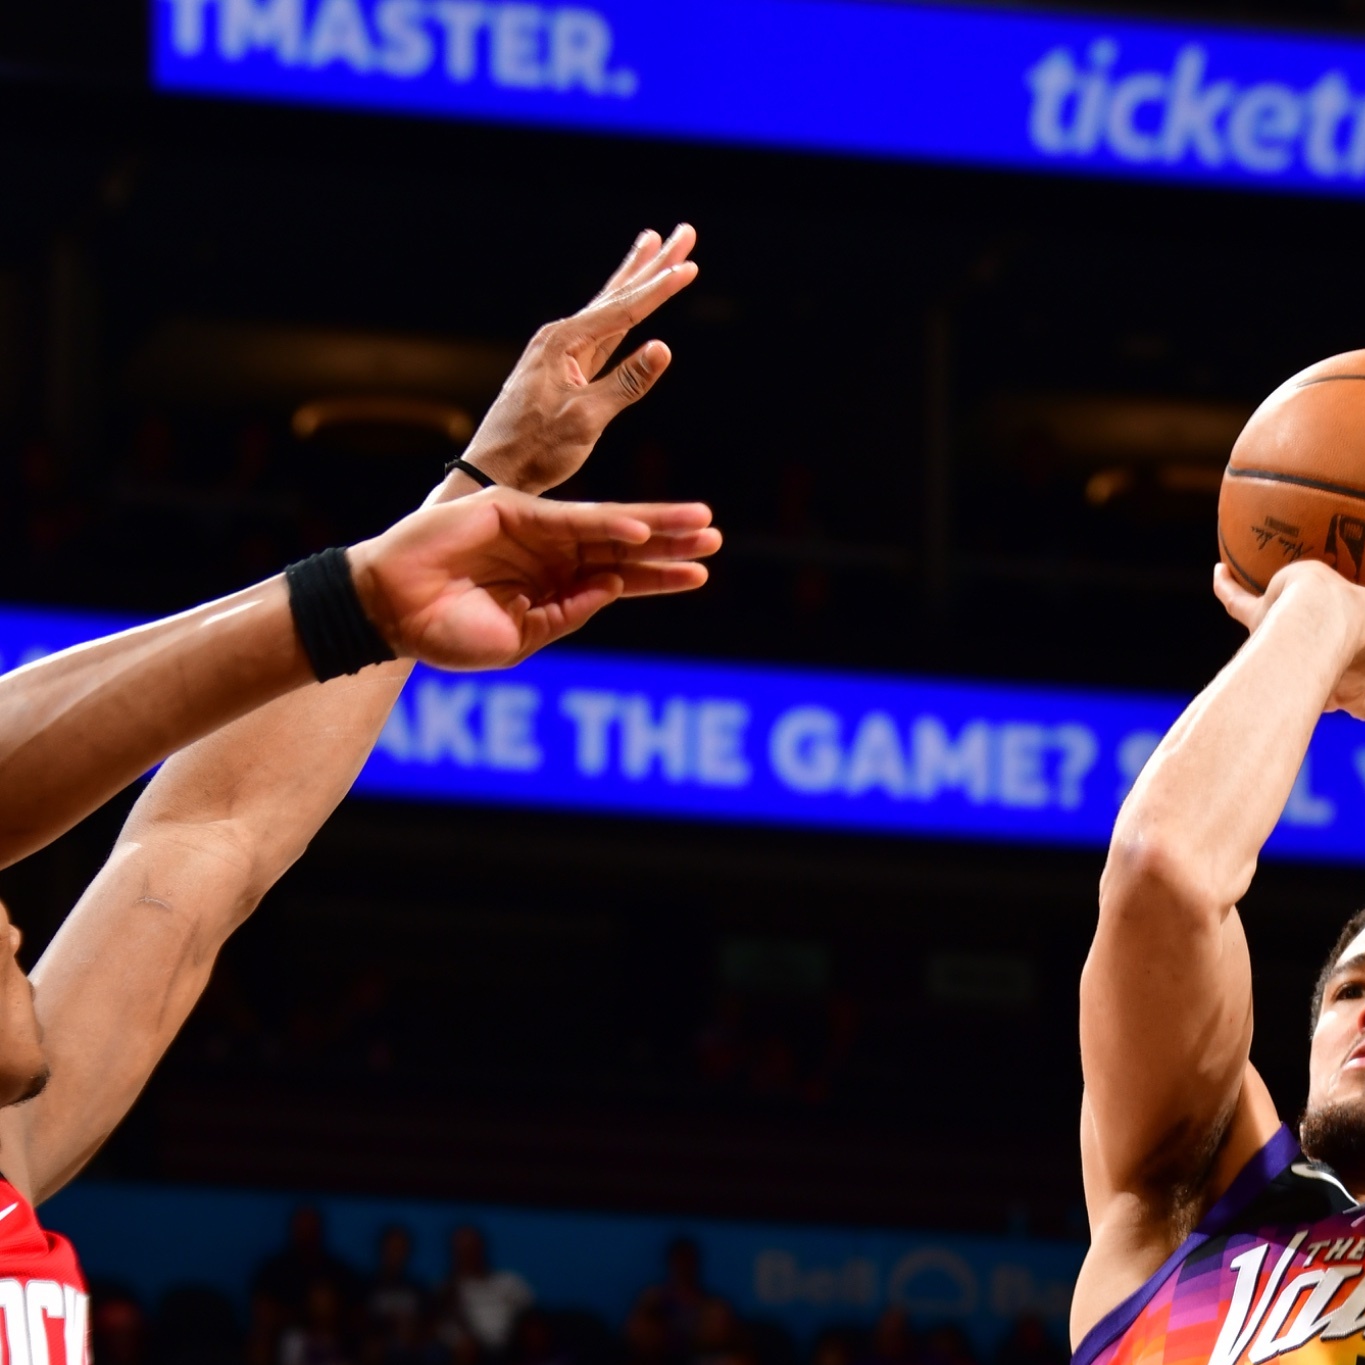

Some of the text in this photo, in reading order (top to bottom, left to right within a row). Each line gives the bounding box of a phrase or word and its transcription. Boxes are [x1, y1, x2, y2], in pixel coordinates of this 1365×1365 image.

[378, 676, 543, 773] AKE
[558, 690, 750, 788] THE
[768, 704, 1098, 812] GAME?
